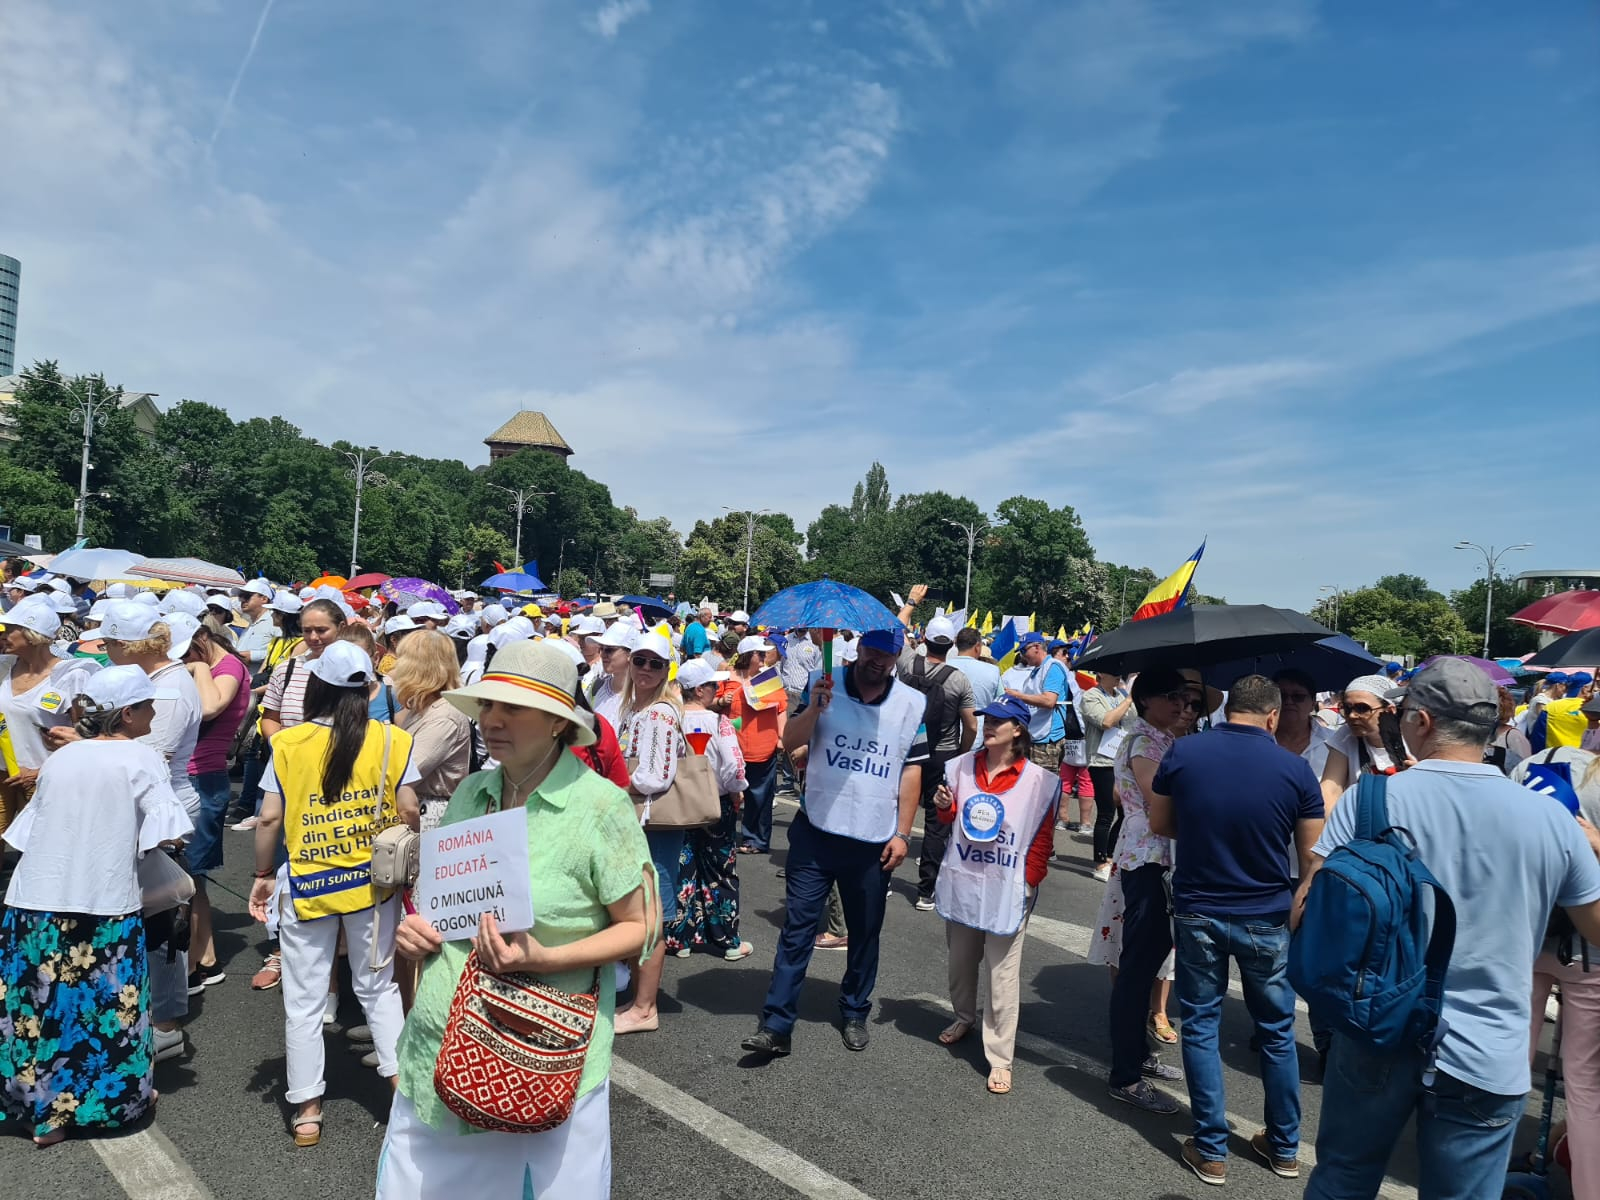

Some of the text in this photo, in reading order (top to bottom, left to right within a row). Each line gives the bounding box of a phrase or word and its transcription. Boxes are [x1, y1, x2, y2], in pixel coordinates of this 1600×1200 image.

[834, 734, 889, 757] C.J.S.I
[826, 748, 891, 779] Vaslui
[302, 830, 327, 844] din
[438, 829, 493, 853] ROMÂNIA
[435, 854, 488, 880] EDUCATĂ
[956, 843, 1018, 869] Vaslui
[430, 880, 504, 910] O MINCIUNĂ
